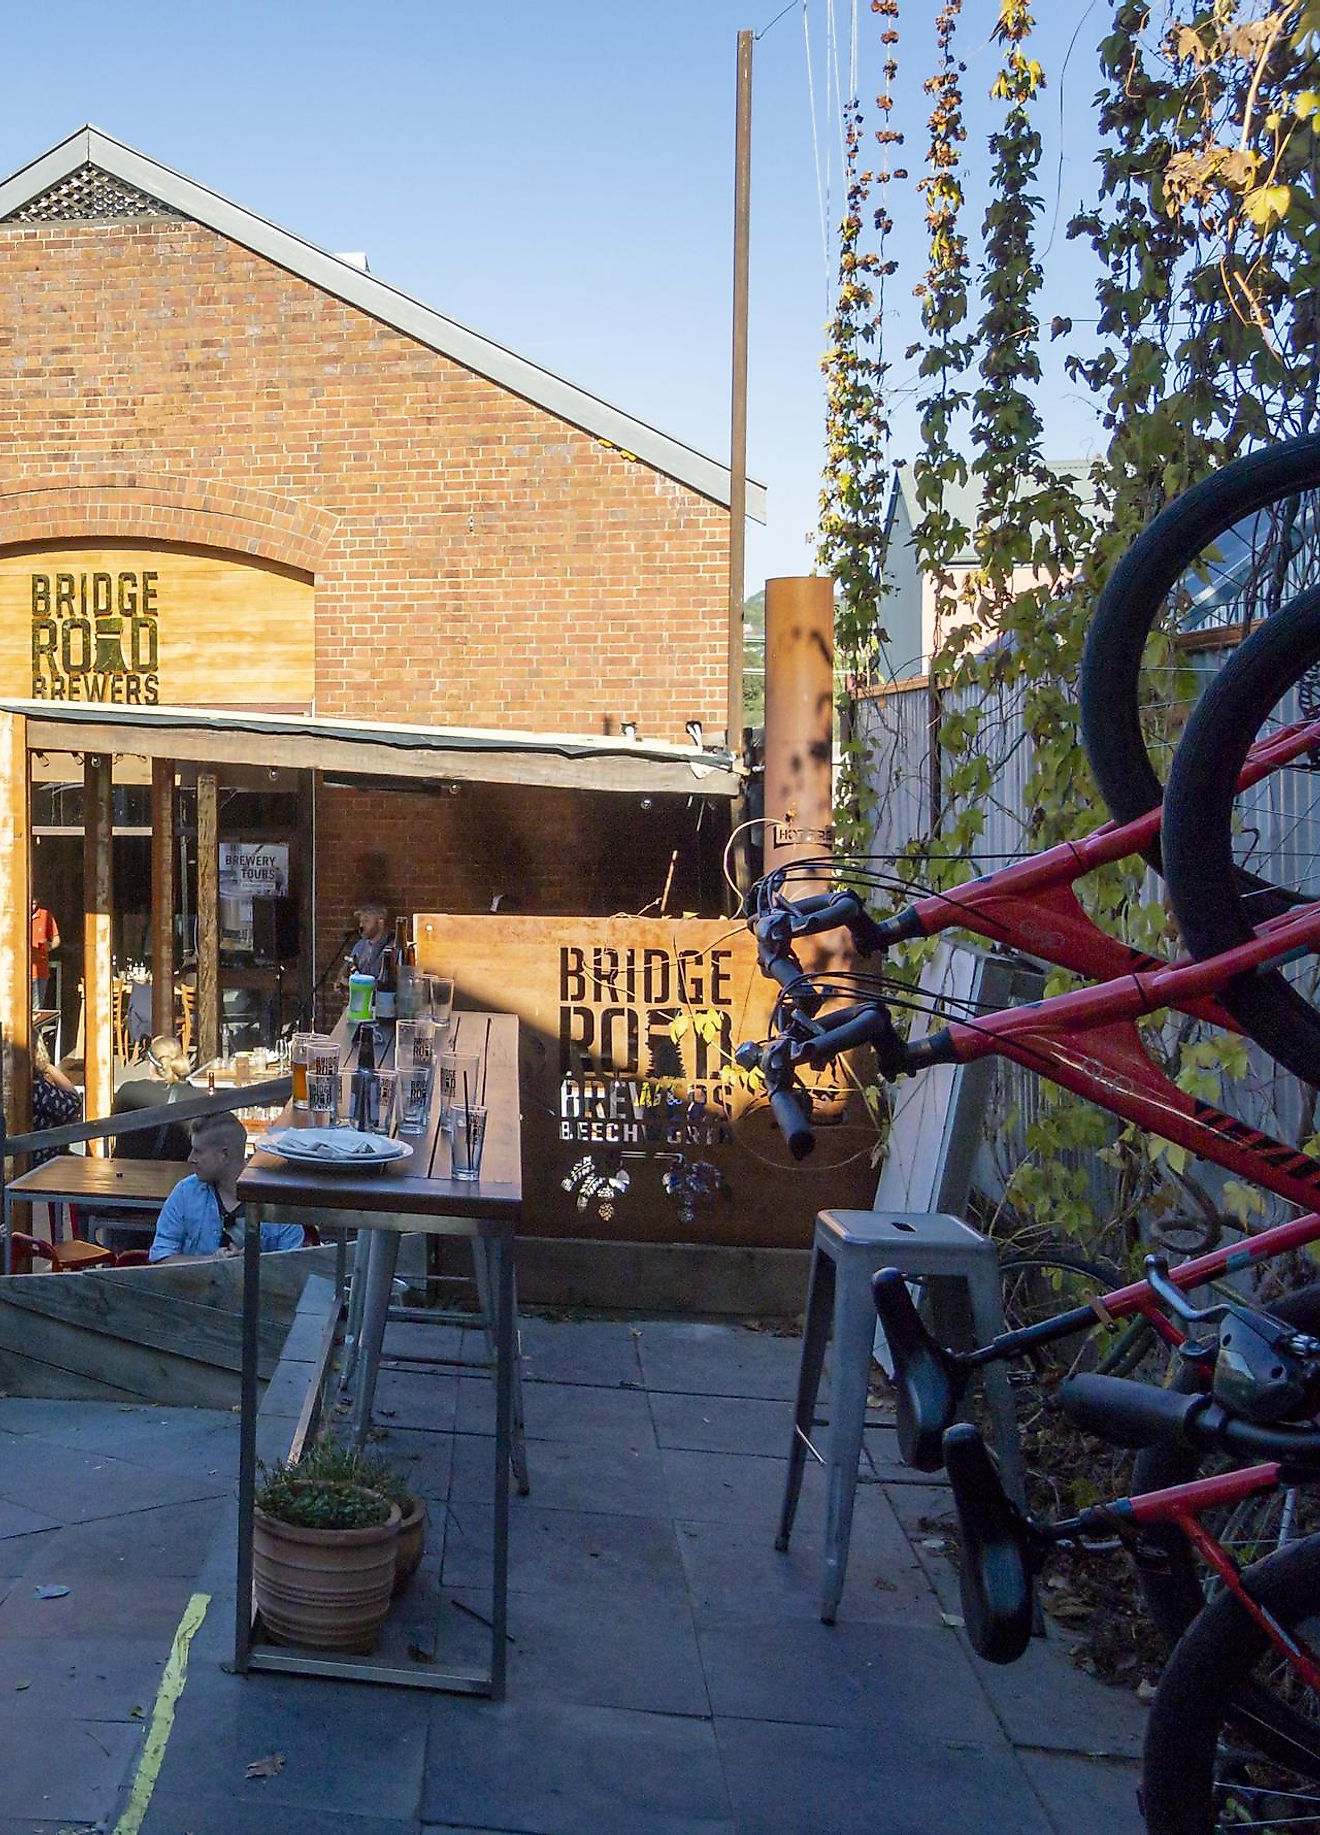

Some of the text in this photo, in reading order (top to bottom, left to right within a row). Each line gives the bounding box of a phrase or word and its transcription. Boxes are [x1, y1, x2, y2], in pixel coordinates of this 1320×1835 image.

[32, 571, 158, 618] BRIDGE
[32, 673, 159, 705] BREWERS
[225, 855, 276, 867] BREWERY
[241, 868, 275, 880] TOURS
[560, 947, 732, 1005] BRIDGE
